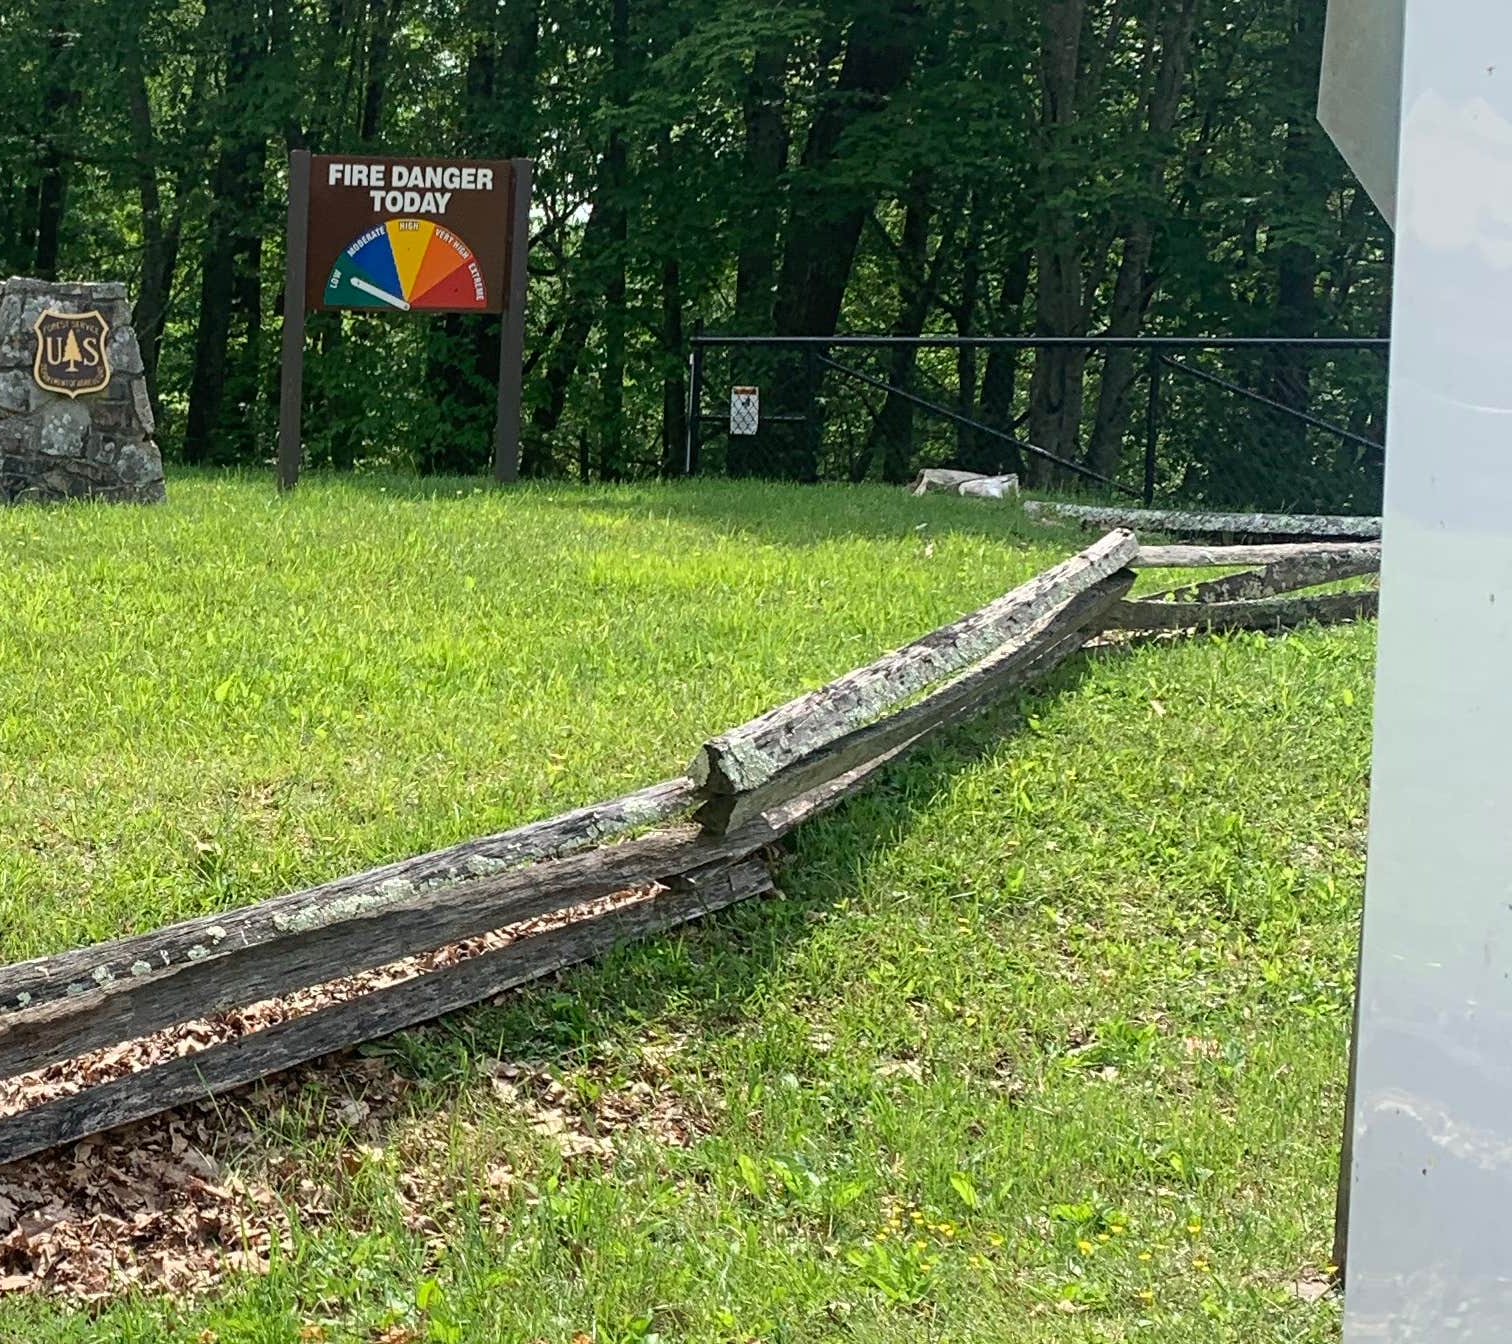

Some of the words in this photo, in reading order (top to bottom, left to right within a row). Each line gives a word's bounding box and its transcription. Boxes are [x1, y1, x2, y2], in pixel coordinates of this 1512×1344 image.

[328, 164, 385, 187] FIRE
[391, 165, 494, 190] DANGER
[370, 190, 452, 214] TODAY
[399, 221, 420, 231] HIGH
[346, 226, 386, 258] MODERATE
[435, 228, 454, 246] VERY
[452, 241, 472, 260] HIGH
[329, 268, 342, 289] LOW
[467, 262, 485, 301] EXTREME
